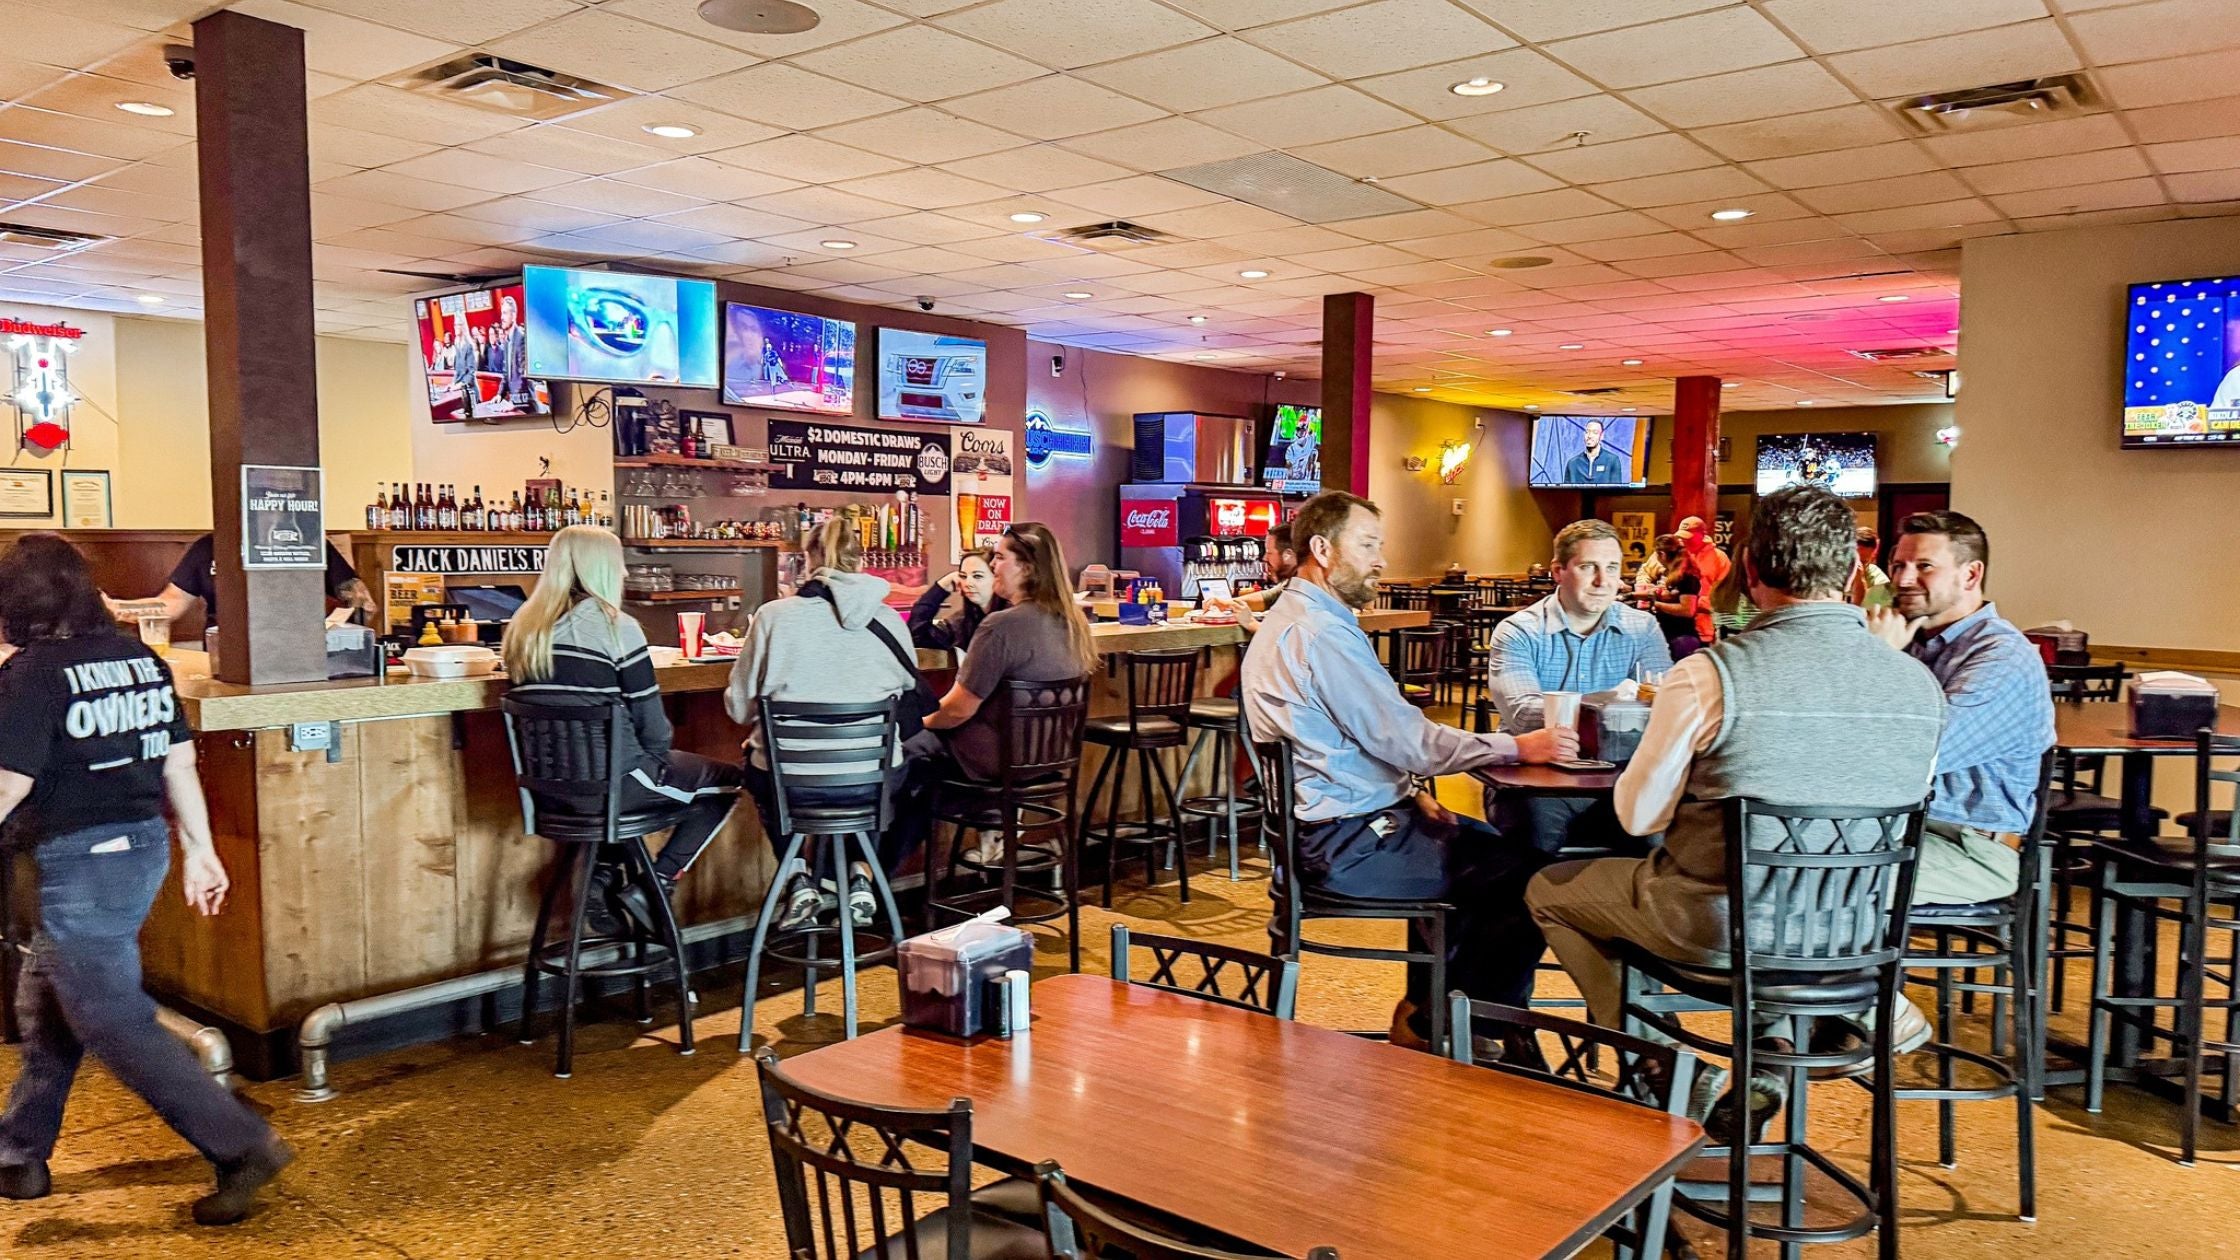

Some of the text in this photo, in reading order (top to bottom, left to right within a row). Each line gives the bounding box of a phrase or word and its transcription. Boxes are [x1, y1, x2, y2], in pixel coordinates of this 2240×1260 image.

[0, 319, 82, 338] Budweiser
[807, 427, 822, 443] $2
[824, 430, 881, 447] DOMESTIC
[882, 434, 921, 450] DRAWS
[960, 431, 1005, 454] Coors
[769, 444, 811, 457] ULTRA
[873, 453, 912, 468] FRIDAY
[918, 457, 948, 469] BUSCH
[840, 471, 892, 486] 4PM-6PM
[249, 499, 319, 512] HAPPY HOUR!
[983, 497, 1006, 509] NOW
[987, 509, 1001, 519] ON
[978, 520, 1010, 531] DRAFT
[1714, 520, 1734, 532] SY
[403, 549, 452, 571] JACK
[457, 548, 528, 571] DANIEL'S
[389, 589, 418, 600] BEER
[64, 657, 164, 694] I KNOW THE
[66, 685, 175, 739] OWNERS
[140, 729, 171, 760] TOO
